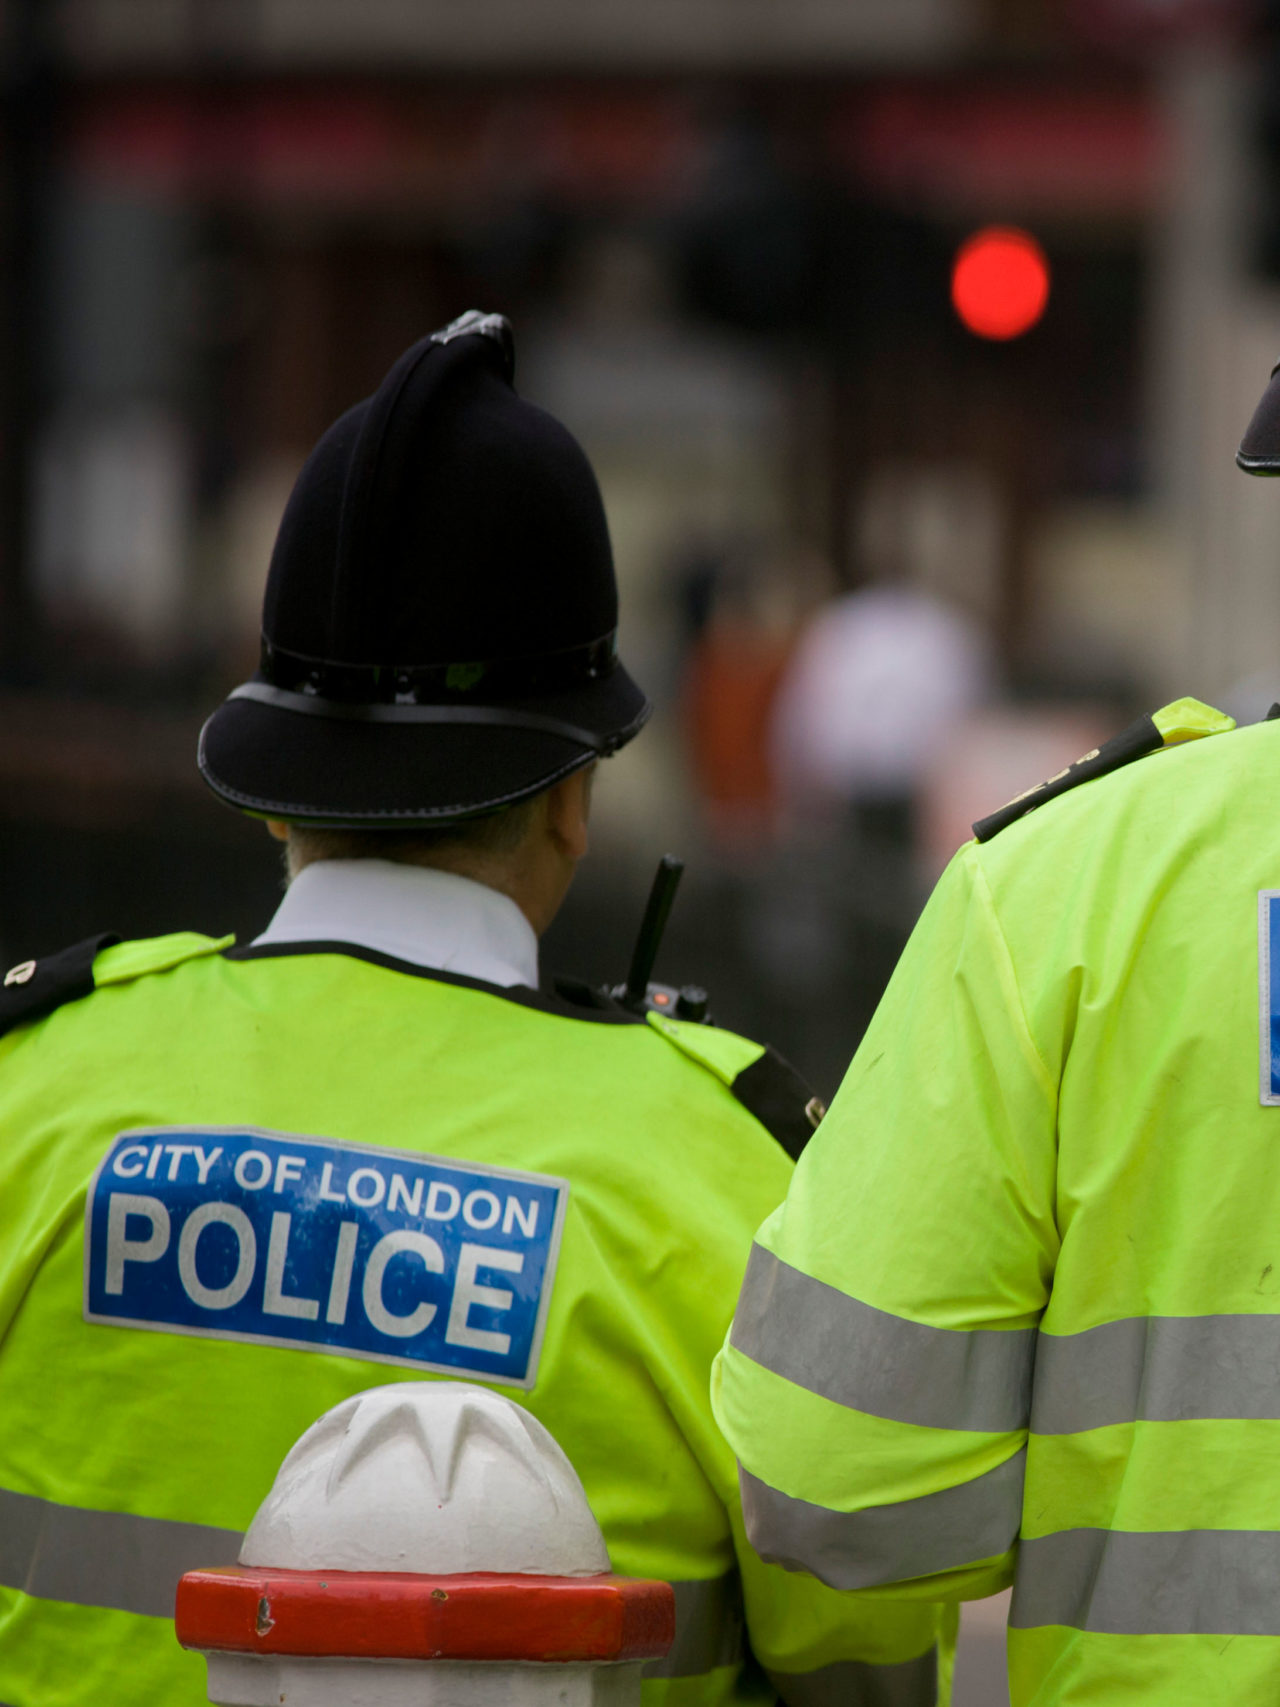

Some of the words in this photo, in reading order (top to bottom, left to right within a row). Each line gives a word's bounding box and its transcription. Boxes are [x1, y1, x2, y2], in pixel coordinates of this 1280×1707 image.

[112, 1144, 223, 1185] CITY
[234, 1150, 306, 1194] OF
[318, 1162, 540, 1239] LONDON
[104, 1192, 525, 1355] POLICE
